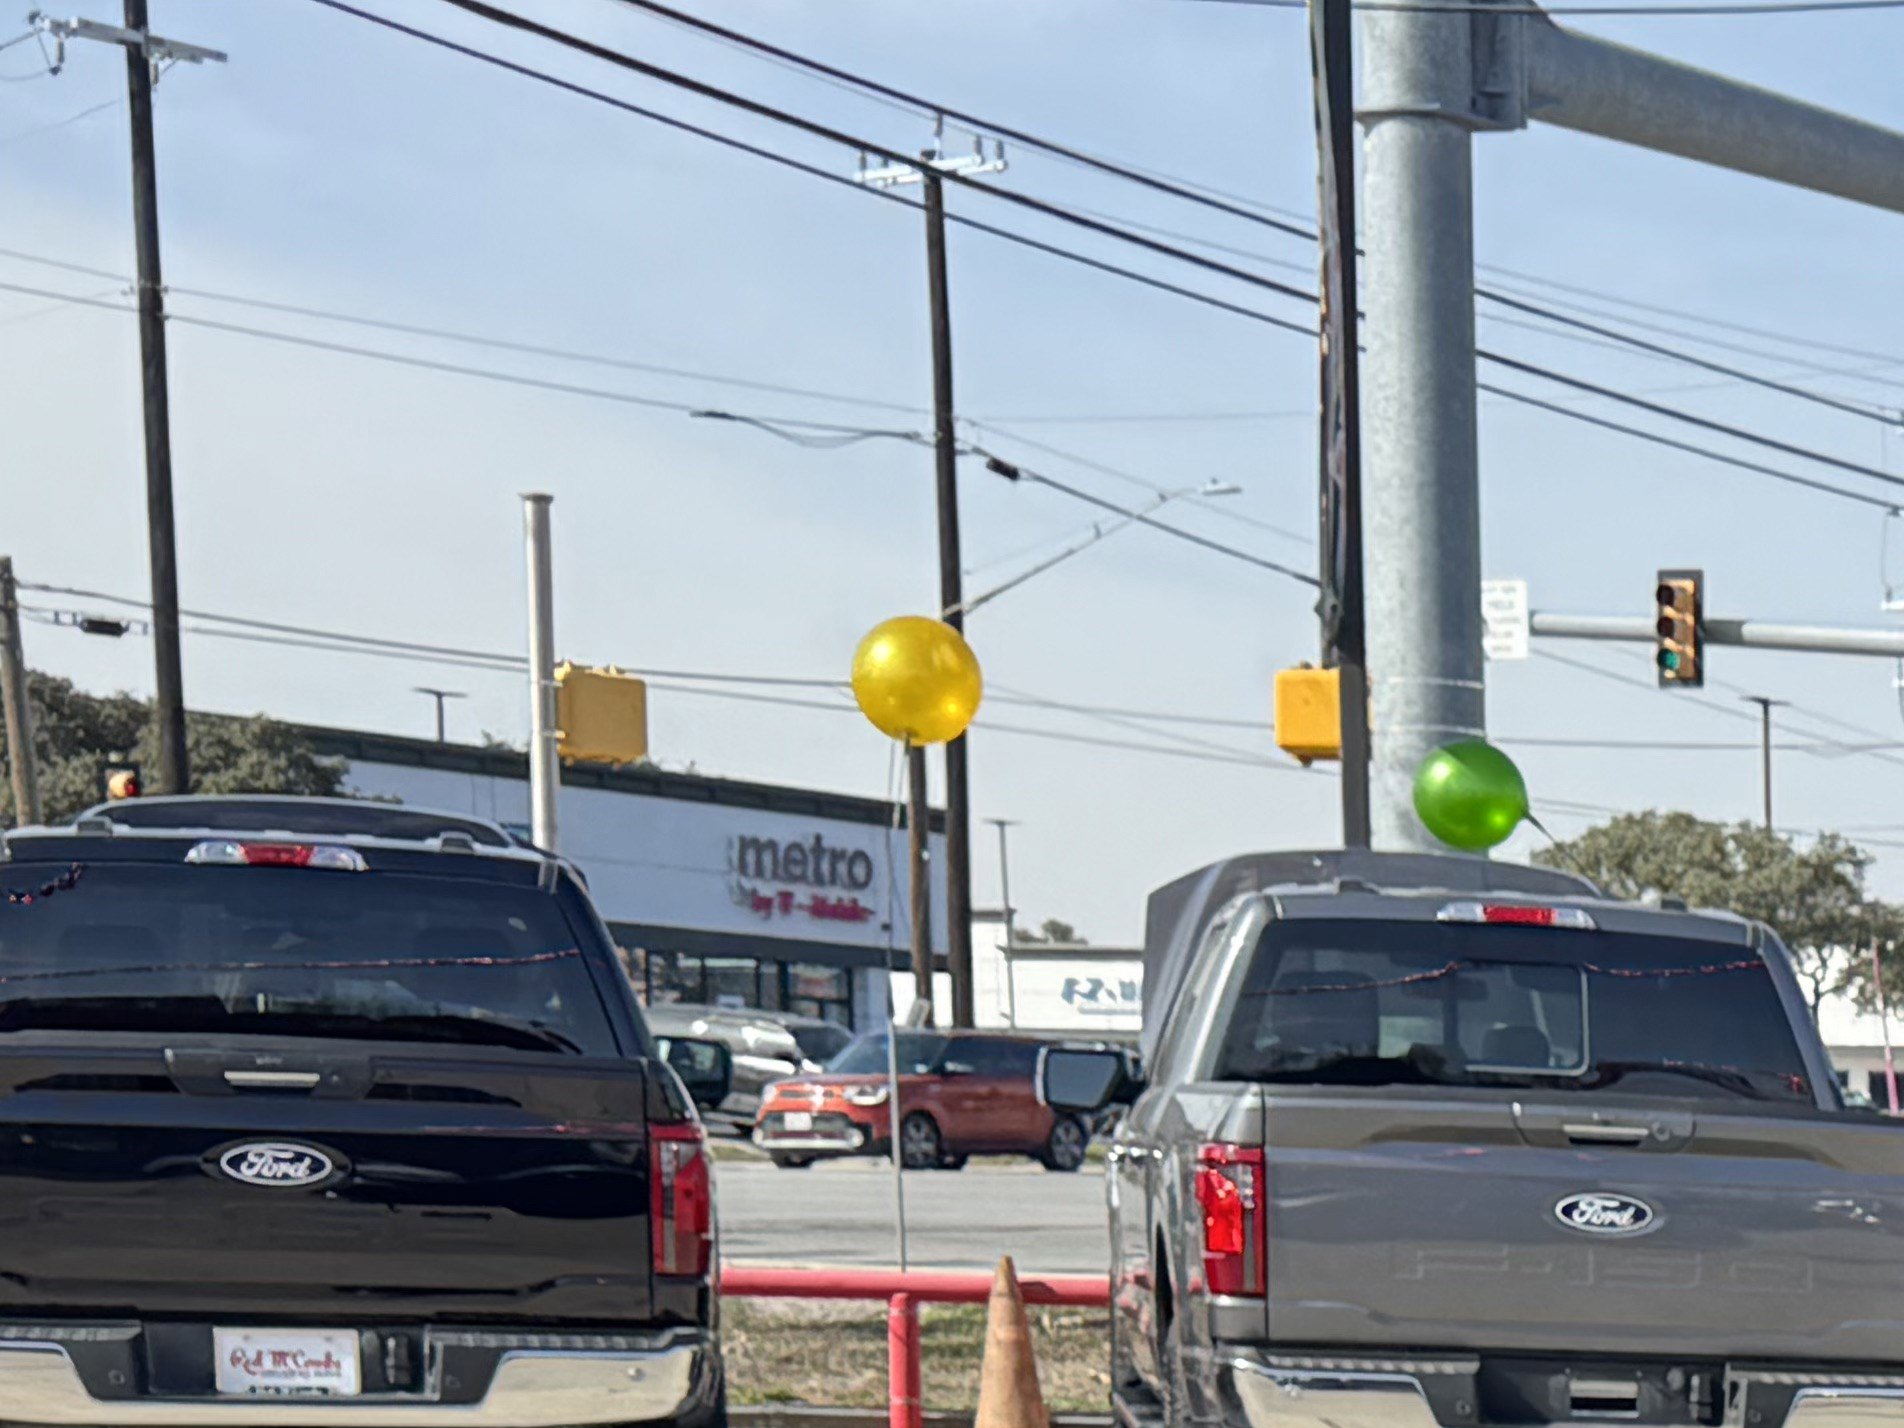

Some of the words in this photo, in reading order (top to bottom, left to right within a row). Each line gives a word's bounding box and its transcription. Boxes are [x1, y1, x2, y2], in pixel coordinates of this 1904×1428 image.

[738, 833, 873, 890] metro
[239, 1149, 312, 1178] Ford
[1572, 1200, 1634, 1225] Ford
